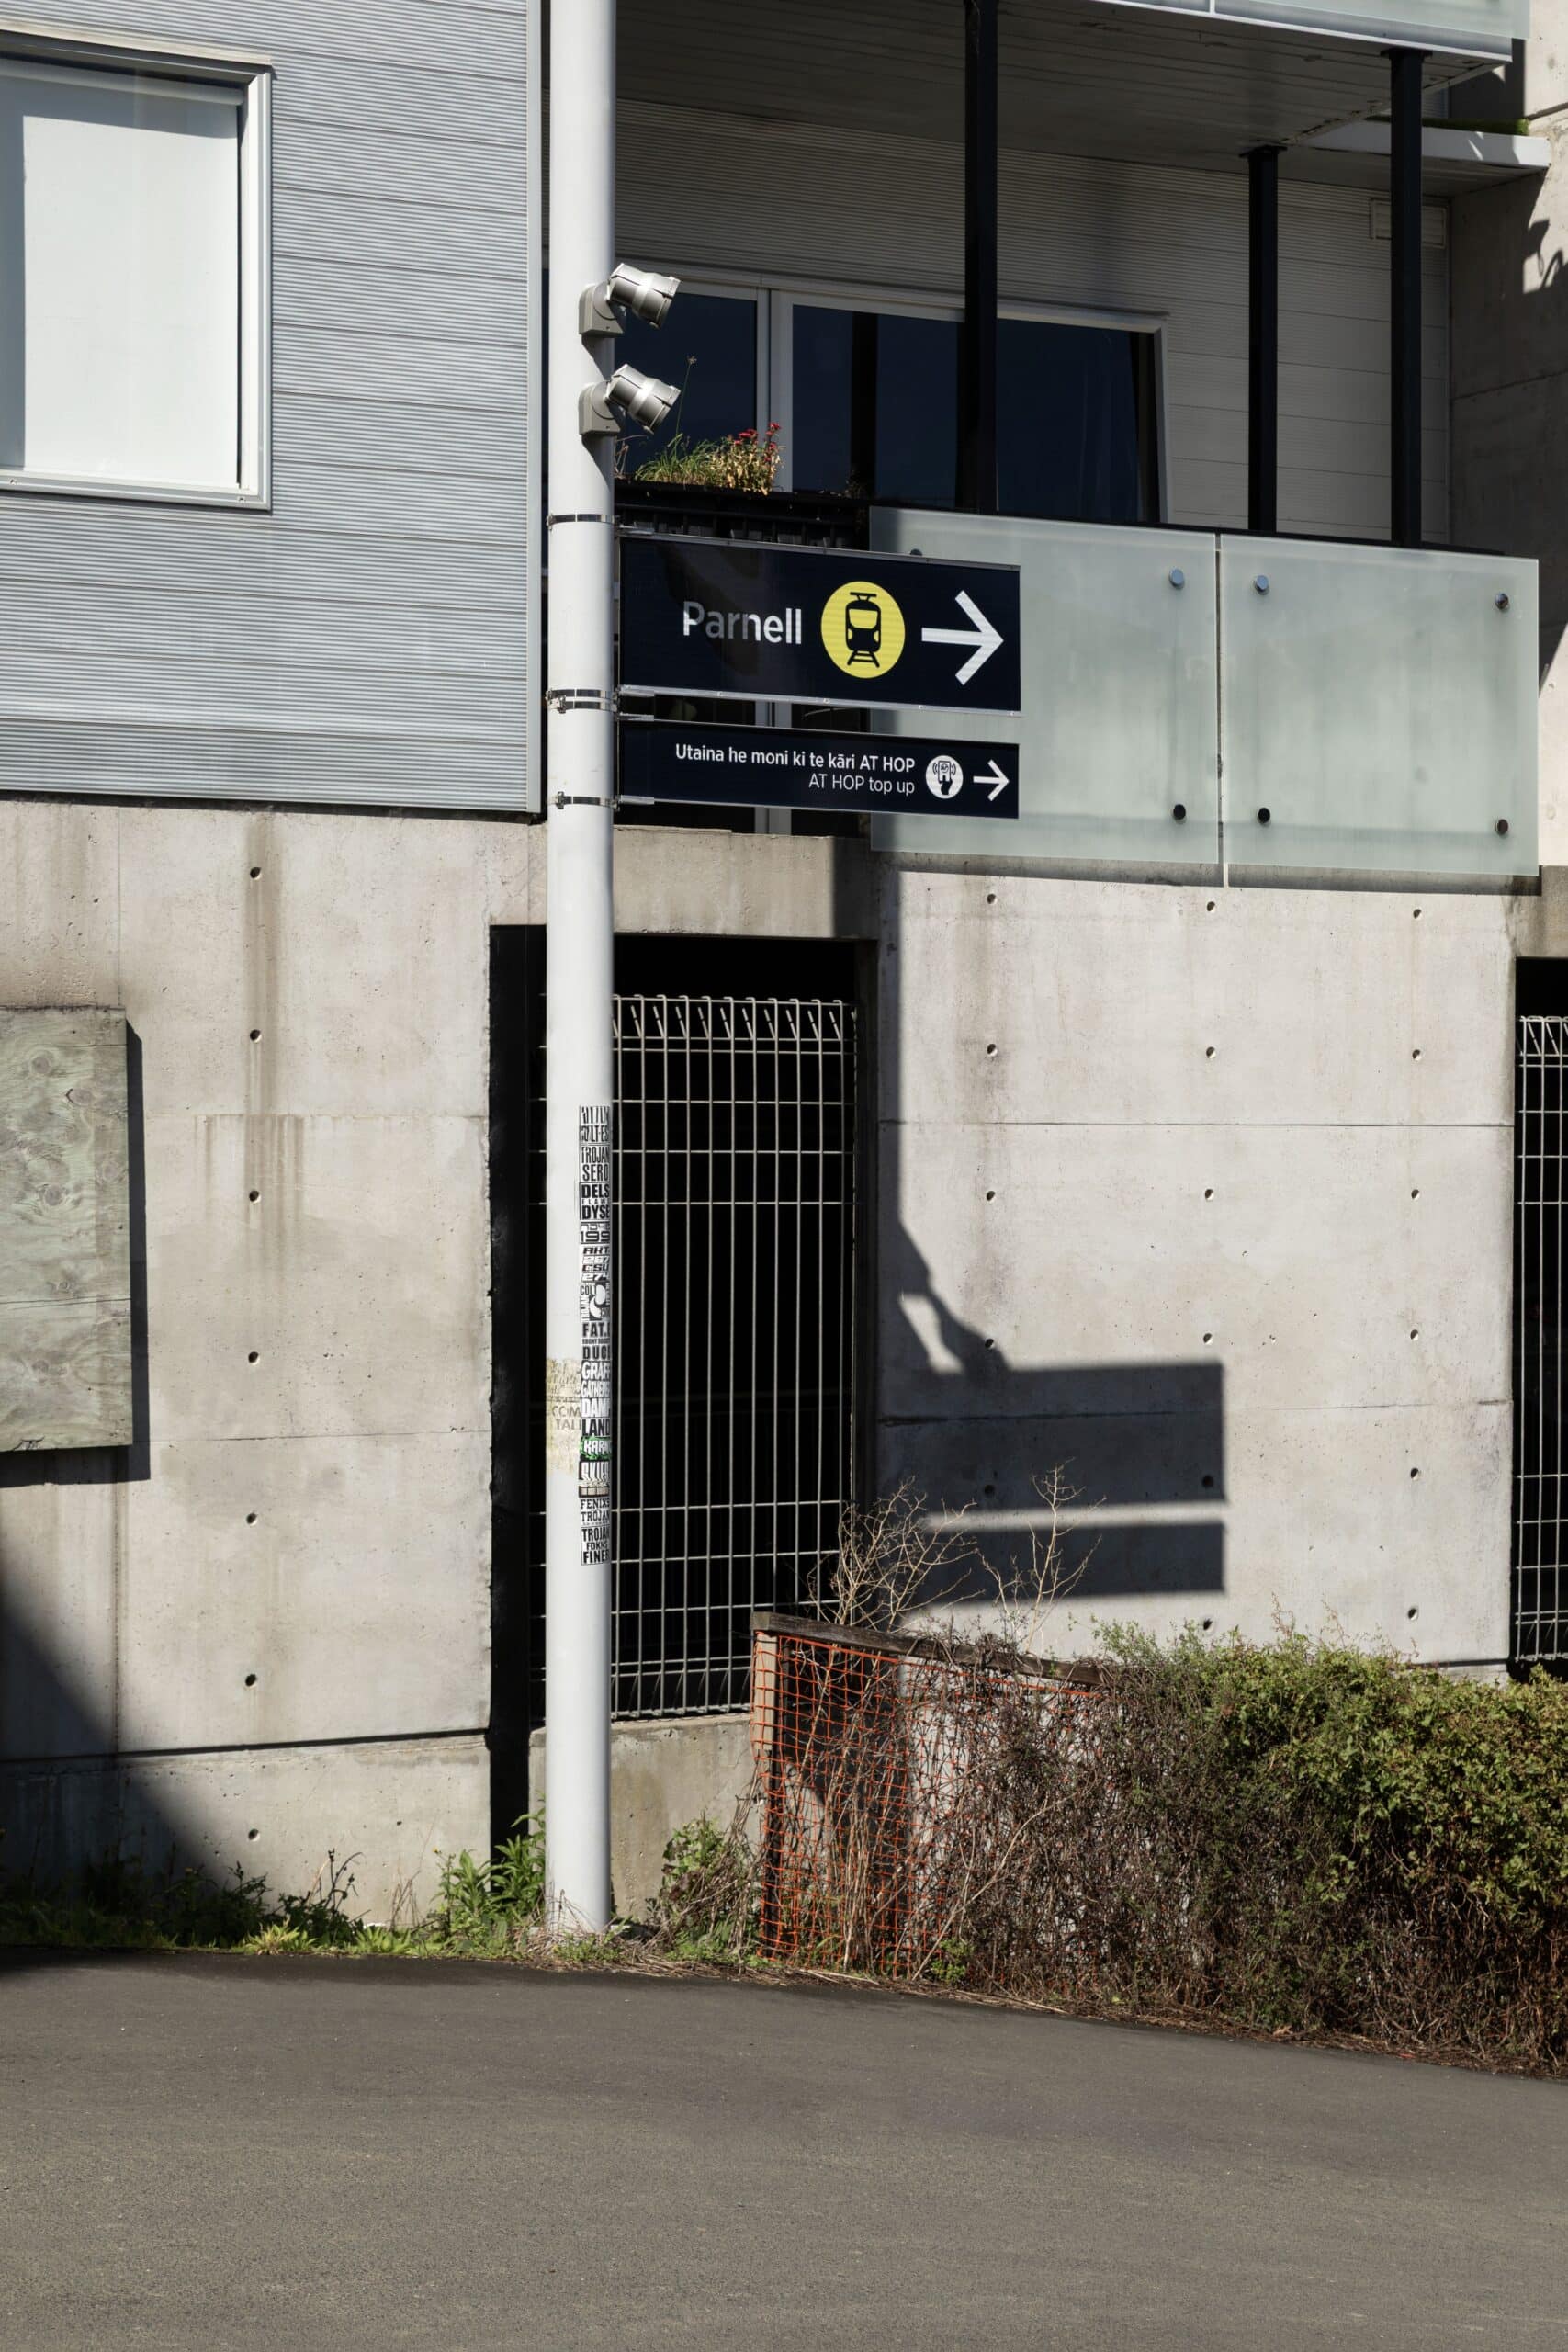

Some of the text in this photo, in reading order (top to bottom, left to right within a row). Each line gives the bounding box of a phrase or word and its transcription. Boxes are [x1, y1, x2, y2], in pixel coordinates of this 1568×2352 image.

[683, 600, 802, 645] Parnell
[675, 743, 916, 773] Utaina he moni ki te kāri AT HOP
[808, 773, 915, 797] AT HOP top up
